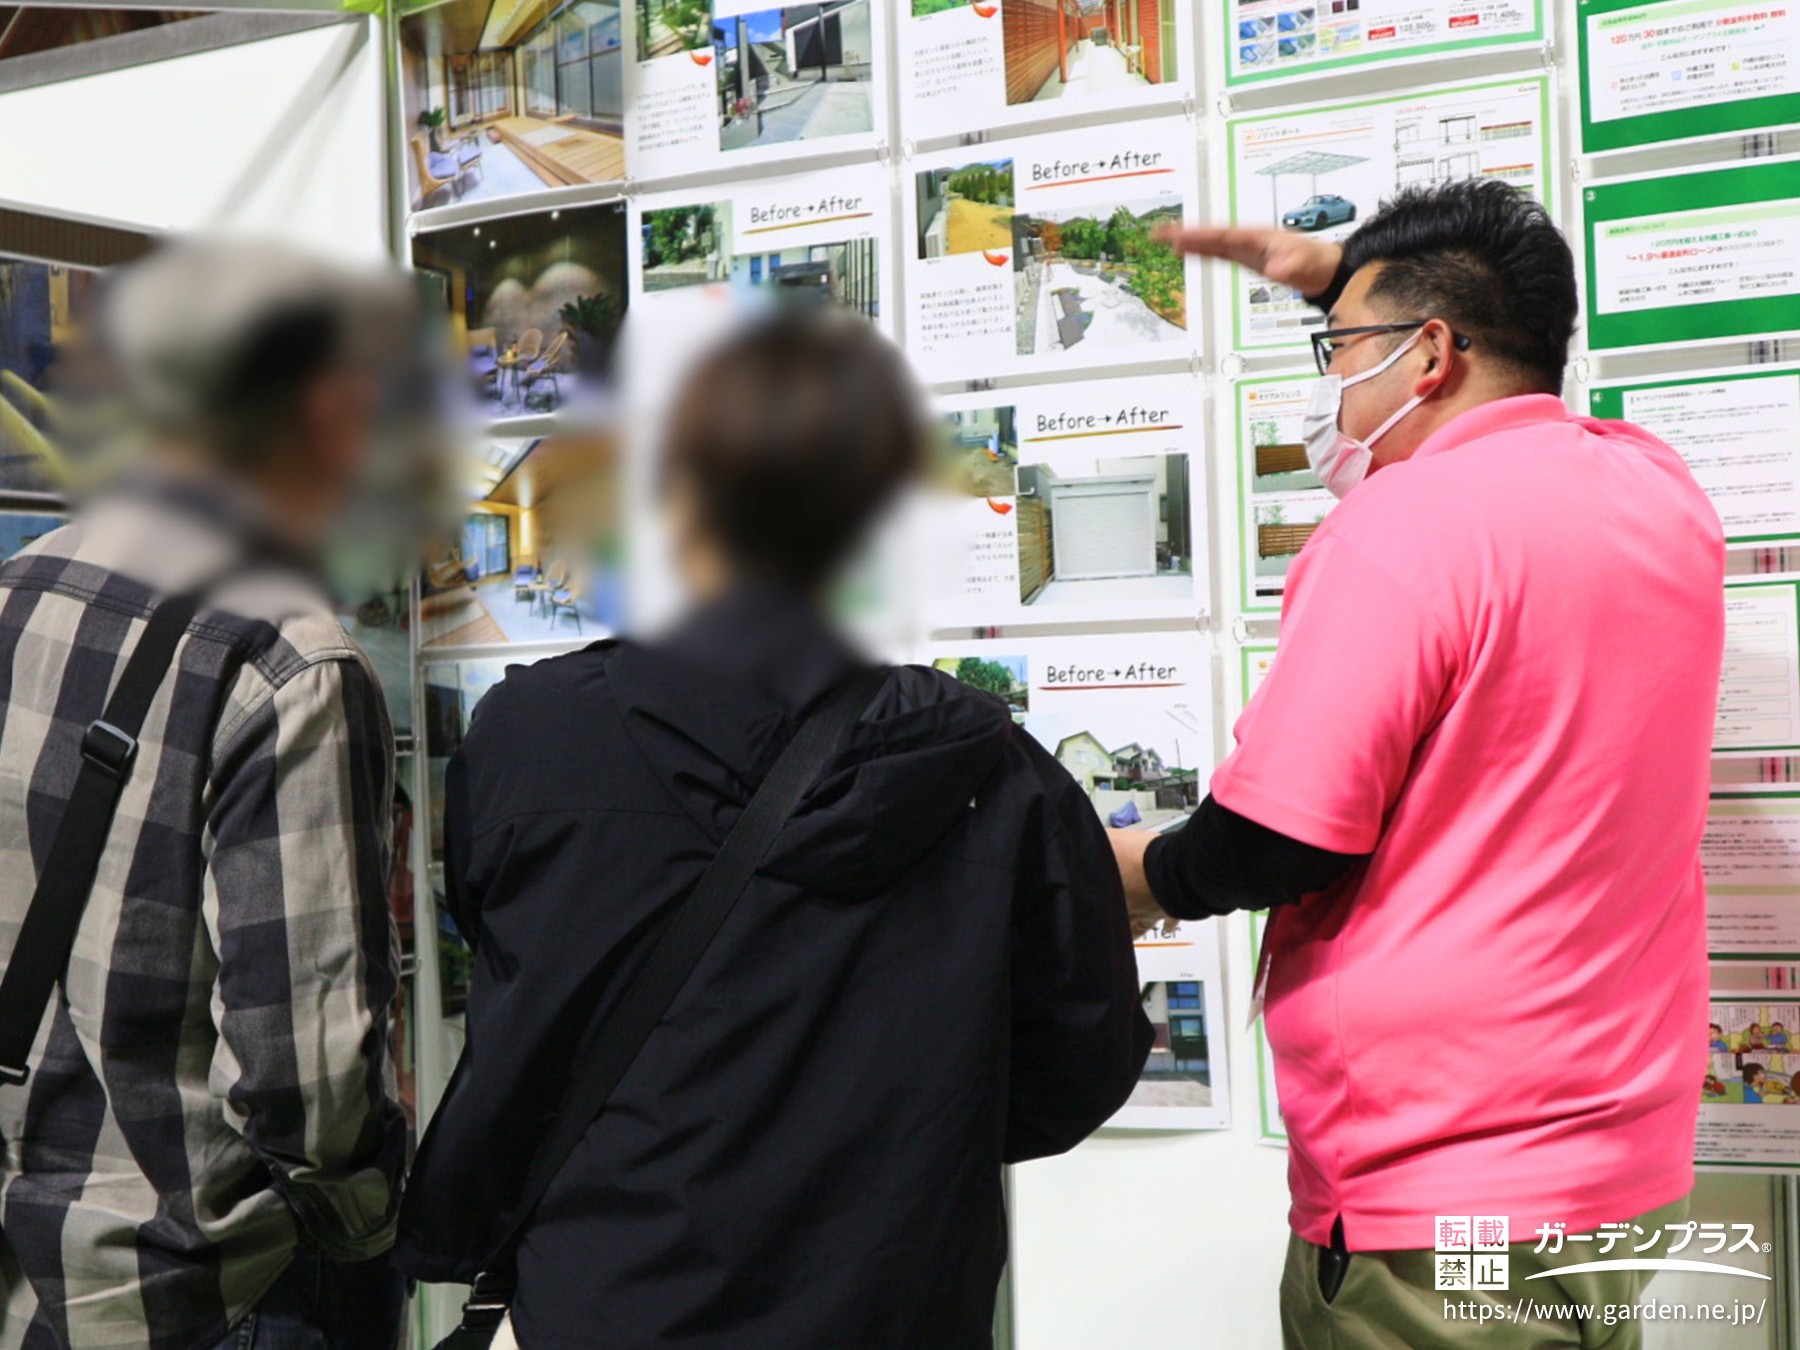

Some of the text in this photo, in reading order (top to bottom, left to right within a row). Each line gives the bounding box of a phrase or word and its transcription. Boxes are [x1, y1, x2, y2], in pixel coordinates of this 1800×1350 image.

[1032, 150, 1162, 181] Before After
[750, 195, 863, 224] Before After
[1036, 406, 1169, 433] Before After
[1047, 661, 1177, 683] Before After
